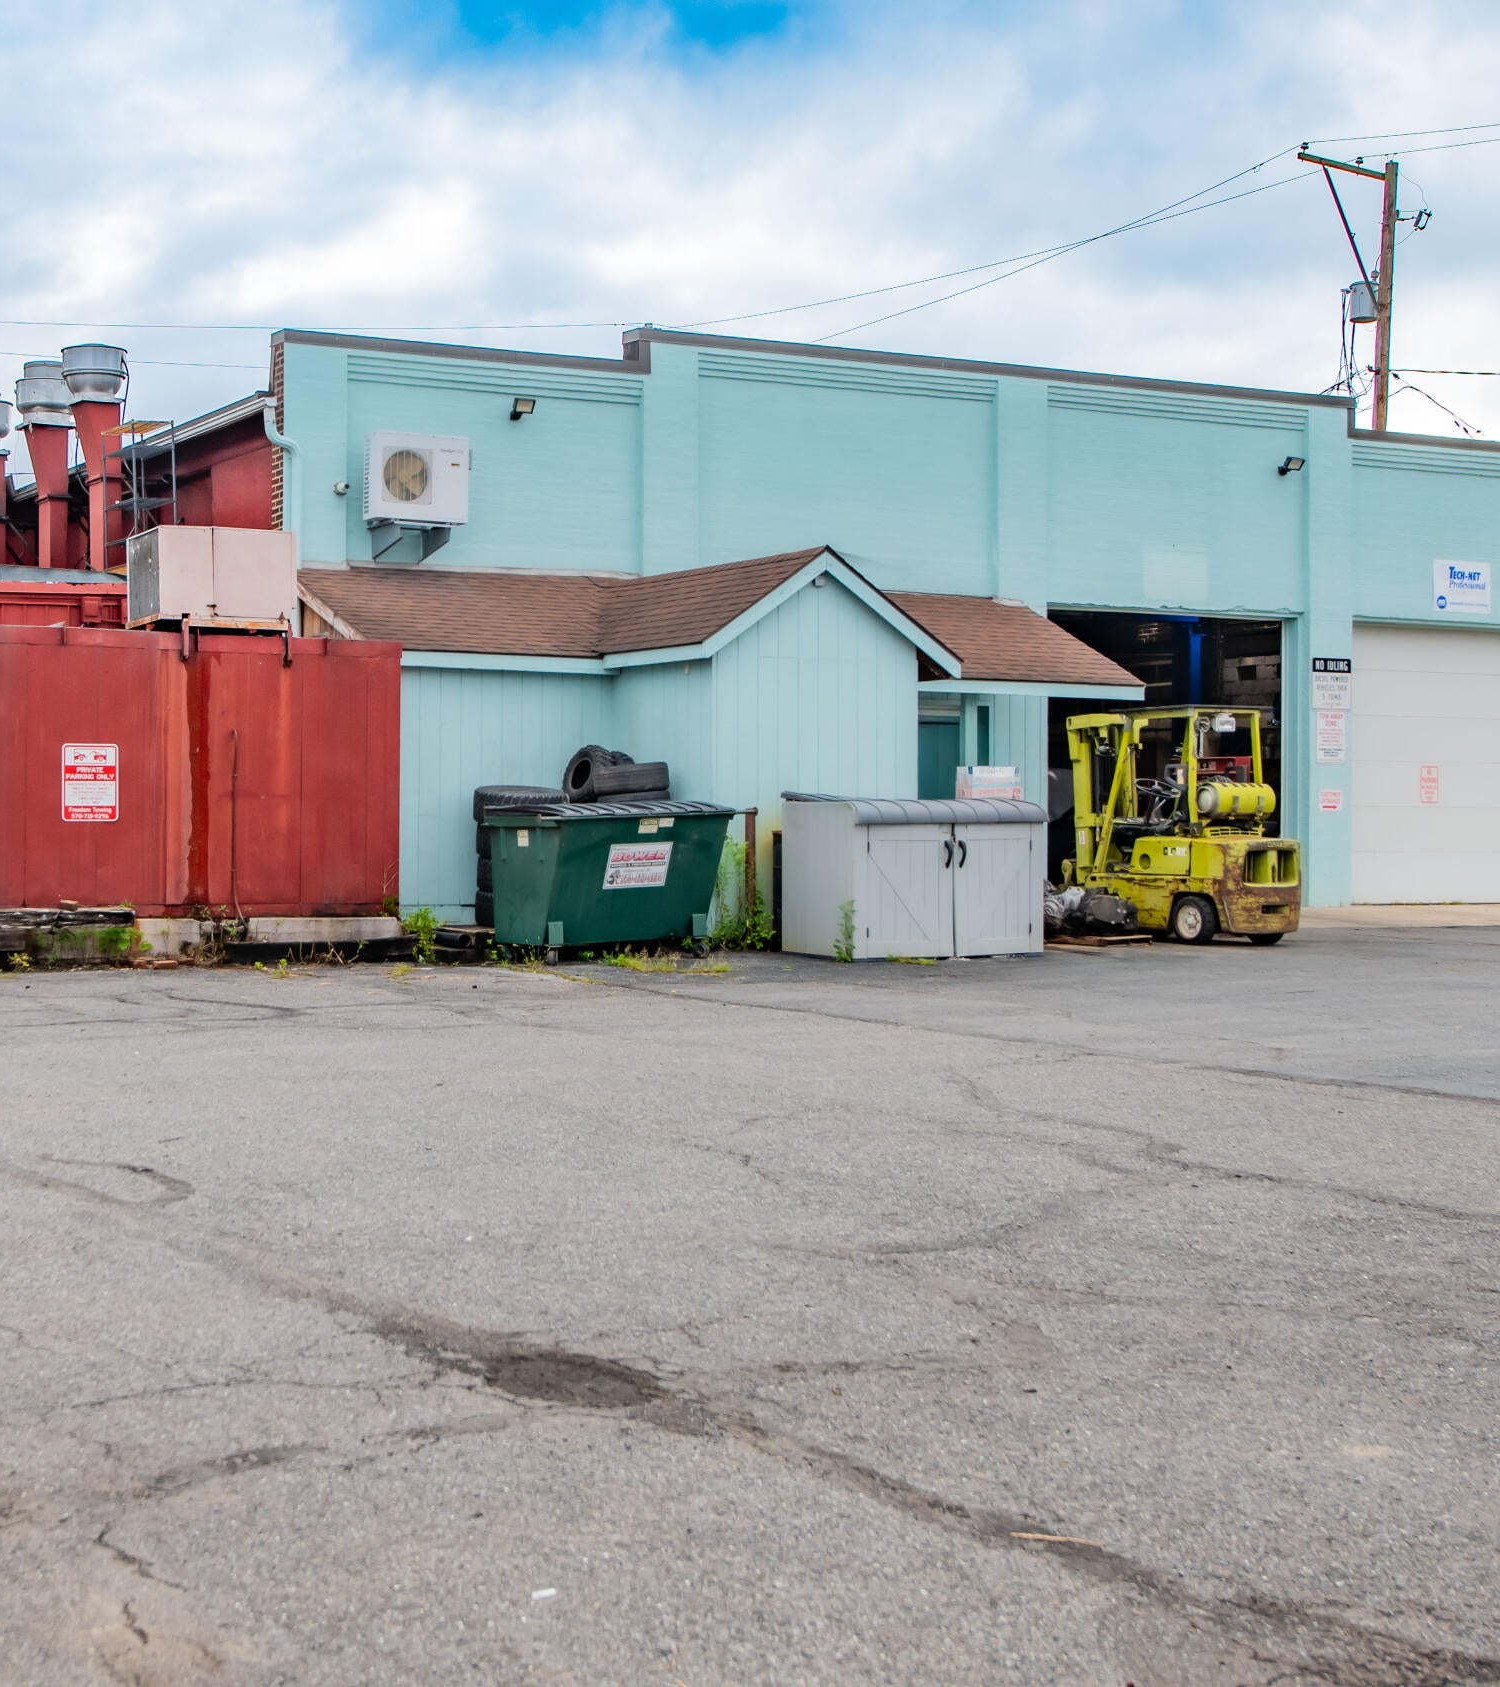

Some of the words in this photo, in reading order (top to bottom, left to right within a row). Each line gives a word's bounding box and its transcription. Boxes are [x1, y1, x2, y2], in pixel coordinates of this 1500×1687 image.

[1449, 566, 1481, 581] TECH-NET
[1315, 660, 1325, 671] NO
[1327, 660, 1349, 672] IDLING
[76, 766, 105, 774] PRIVATE
[611, 850, 668, 862] BOWER
